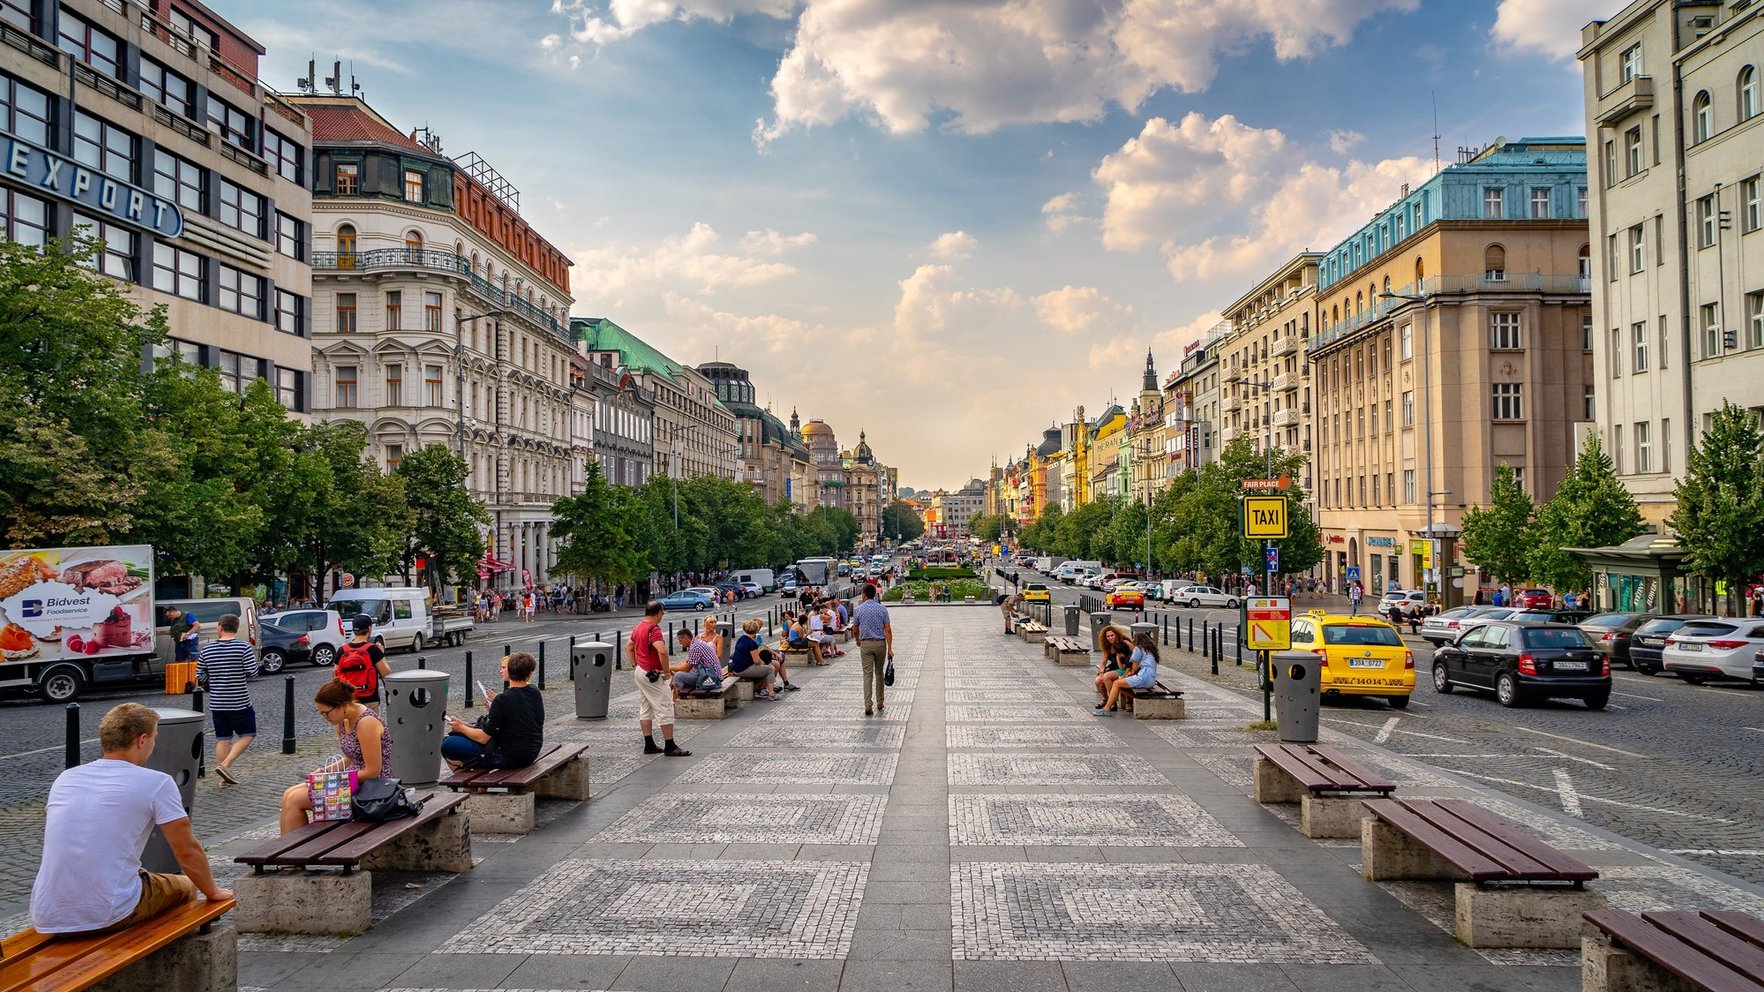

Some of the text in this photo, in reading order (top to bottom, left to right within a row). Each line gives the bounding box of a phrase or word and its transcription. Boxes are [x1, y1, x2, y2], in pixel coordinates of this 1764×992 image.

[7, 140, 168, 228] EXPORT
[1259, 480, 1280, 488] PLACE
[1252, 509, 1279, 525] TAXI
[46, 596, 91, 607] Bidvest
[46, 607, 88, 615] Foodservice
